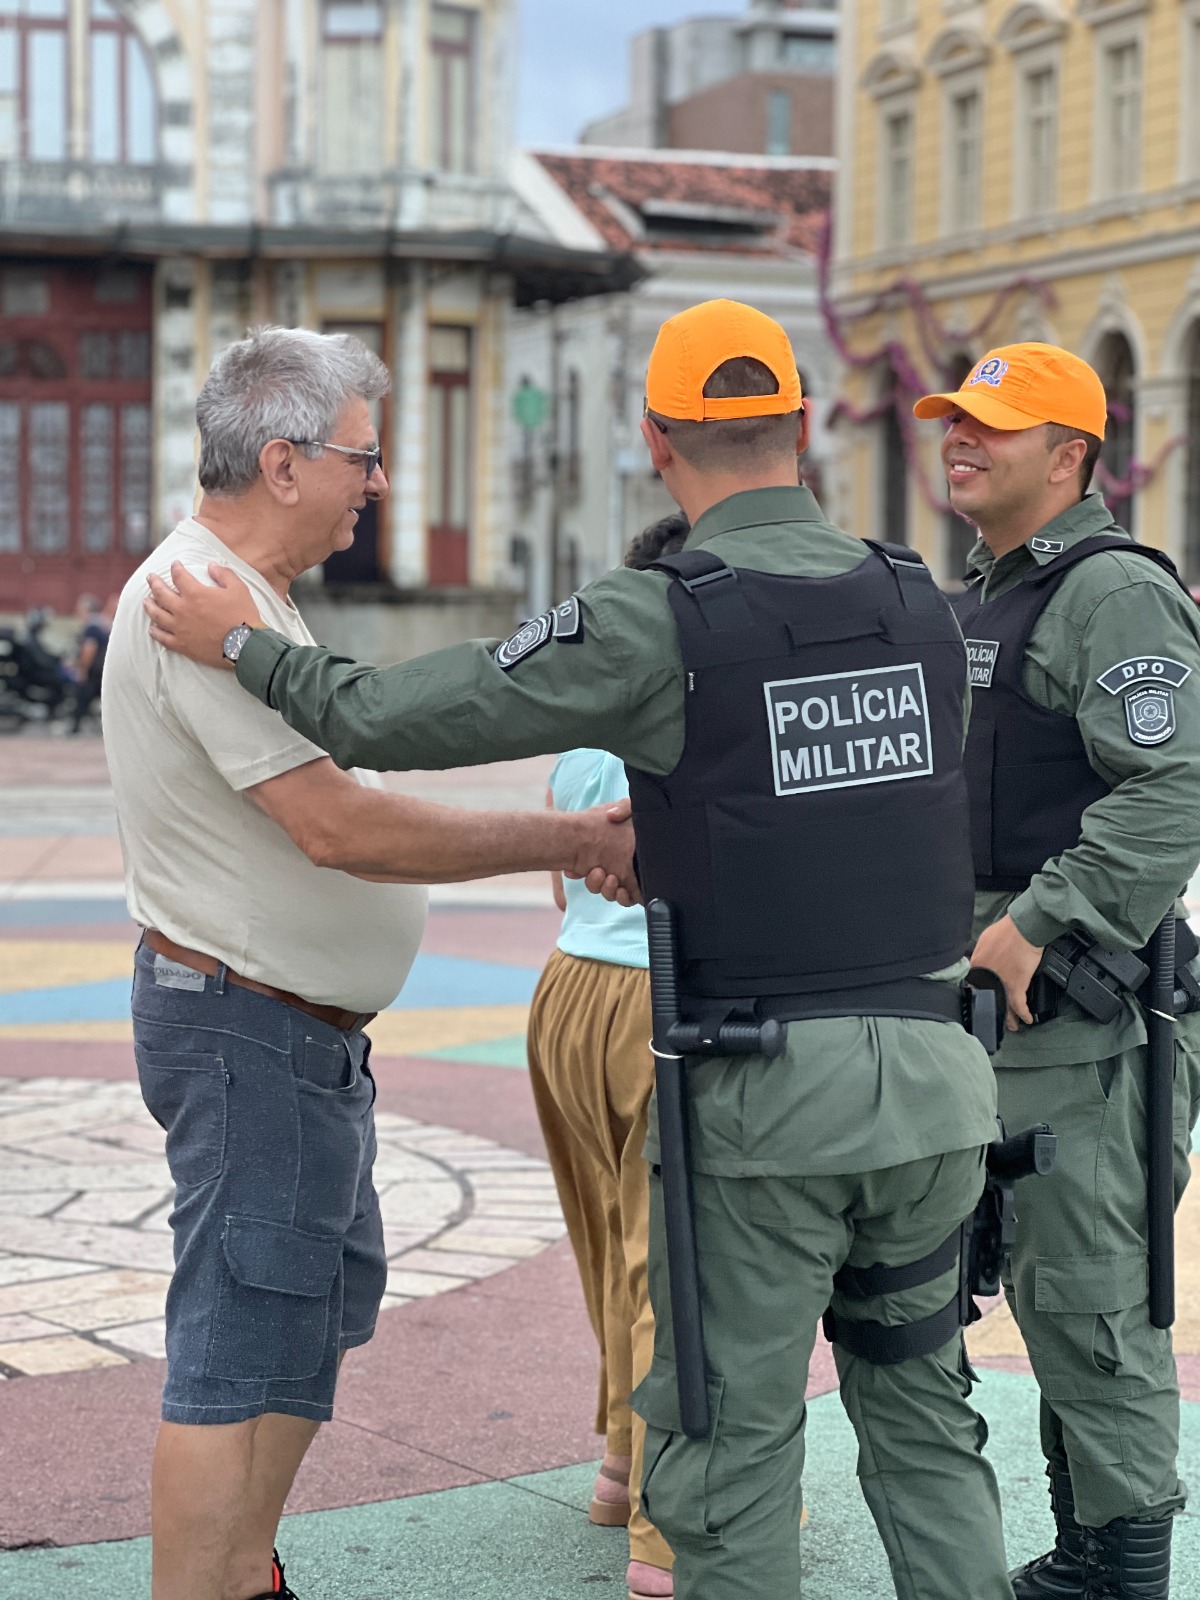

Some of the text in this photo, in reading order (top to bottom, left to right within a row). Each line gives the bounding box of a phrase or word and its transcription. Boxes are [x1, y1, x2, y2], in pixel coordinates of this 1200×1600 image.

[970, 667, 990, 682] ITAR
[1122, 662, 1164, 679] DPO
[775, 683, 921, 735] POLÍCIA
[1134, 726, 1172, 741] PERNAMBUCO
[780, 732, 923, 782] MILITAR
